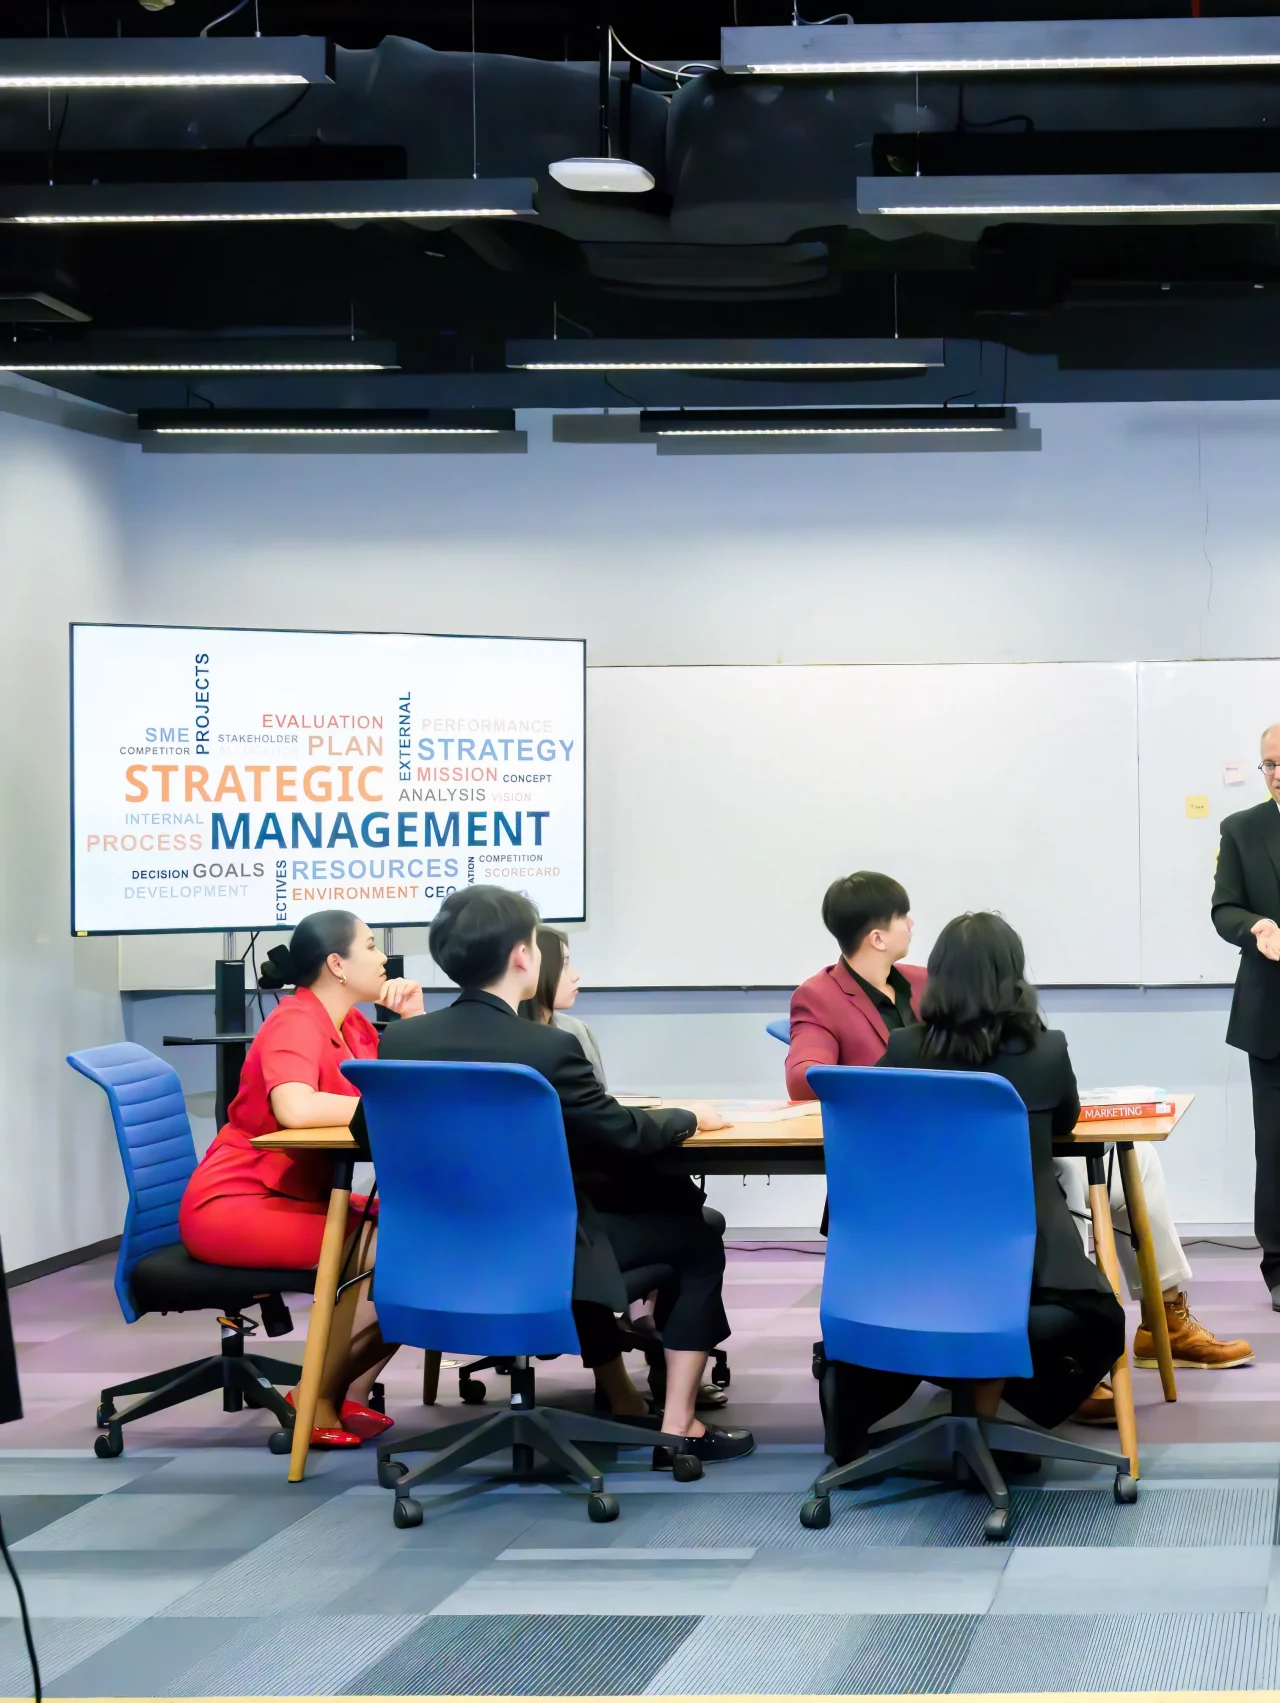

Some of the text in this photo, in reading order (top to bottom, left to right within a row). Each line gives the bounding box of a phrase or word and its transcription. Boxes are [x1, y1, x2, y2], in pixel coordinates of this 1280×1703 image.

[195, 654, 209, 754] PROJECTS
[263, 714, 382, 729] EVALUATION
[422, 719, 553, 733] PERFORMANCE
[146, 728, 189, 742] SME
[218, 734, 298, 743] STAKEHOLDER
[399, 692, 410, 780] EXTERNAL
[120, 747, 189, 755] COMPETITOR
[309, 736, 382, 756] PLAN
[418, 738, 573, 761] STRATEGY
[418, 767, 497, 781] MISSION
[125, 764, 383, 802] STRATEGIC
[399, 789, 485, 801] ANALYSIS
[492, 793, 531, 802] VISION
[126, 813, 204, 824] INTERNAL
[212, 811, 550, 849] MANAGEMENT
[87, 834, 202, 852] PROCESS
[132, 870, 188, 879] DECISION
[193, 863, 264, 878] GOALS
[293, 858, 458, 880] RESOURCES
[467, 856, 475, 886] ATION
[485, 867, 560, 877] SCORECARD
[125, 885, 248, 899] DEVELOPMENT
[293, 886, 418, 900] ENVIRONMENT
[1085, 1107, 1142, 1119] MARKETING
